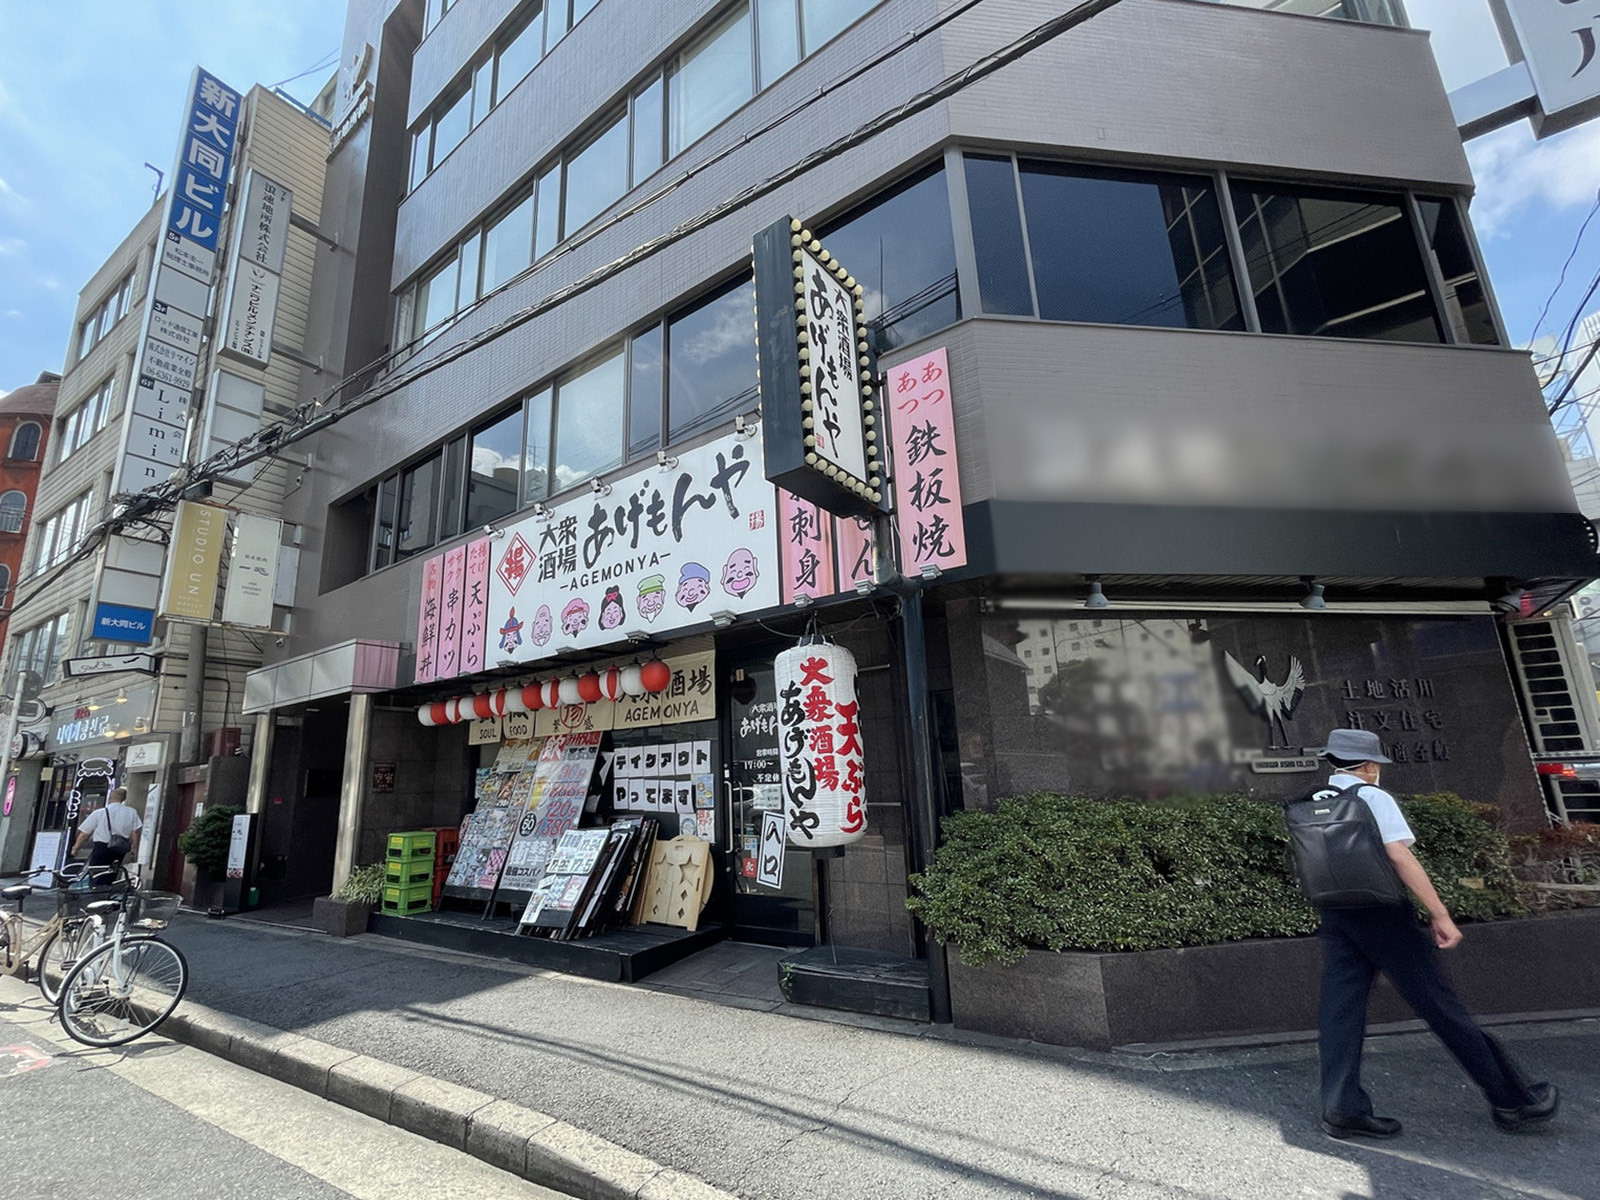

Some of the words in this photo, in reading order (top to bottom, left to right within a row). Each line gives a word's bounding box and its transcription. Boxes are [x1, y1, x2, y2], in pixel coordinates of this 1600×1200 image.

[176, 77, 236, 239] 新大同ビル
[810, 268, 841, 458] あげもんや
[834, 287, 852, 381] 大衆酒場
[583, 444, 750, 569] あげもんや
[905, 419, 955, 562] 鉄板焼
[193, 509, 211, 564] STUDIO
[538, 544, 577, 583] 酒場
[539, 516, 578, 553] 大衆
[789, 495, 822, 590] 刺身
[101, 617, 146, 630] 新大同ビル
[444, 587, 459, 671] 串カツ
[467, 580, 483, 667] 天ぷら
[624, 700, 699, 723] AGEMONYA
[800, 656, 840, 792] 大衆酒場
[616, 749, 708, 770] テイクアウト
[616, 786, 689, 805] やってます
[780, 681, 820, 840] あげもんや
